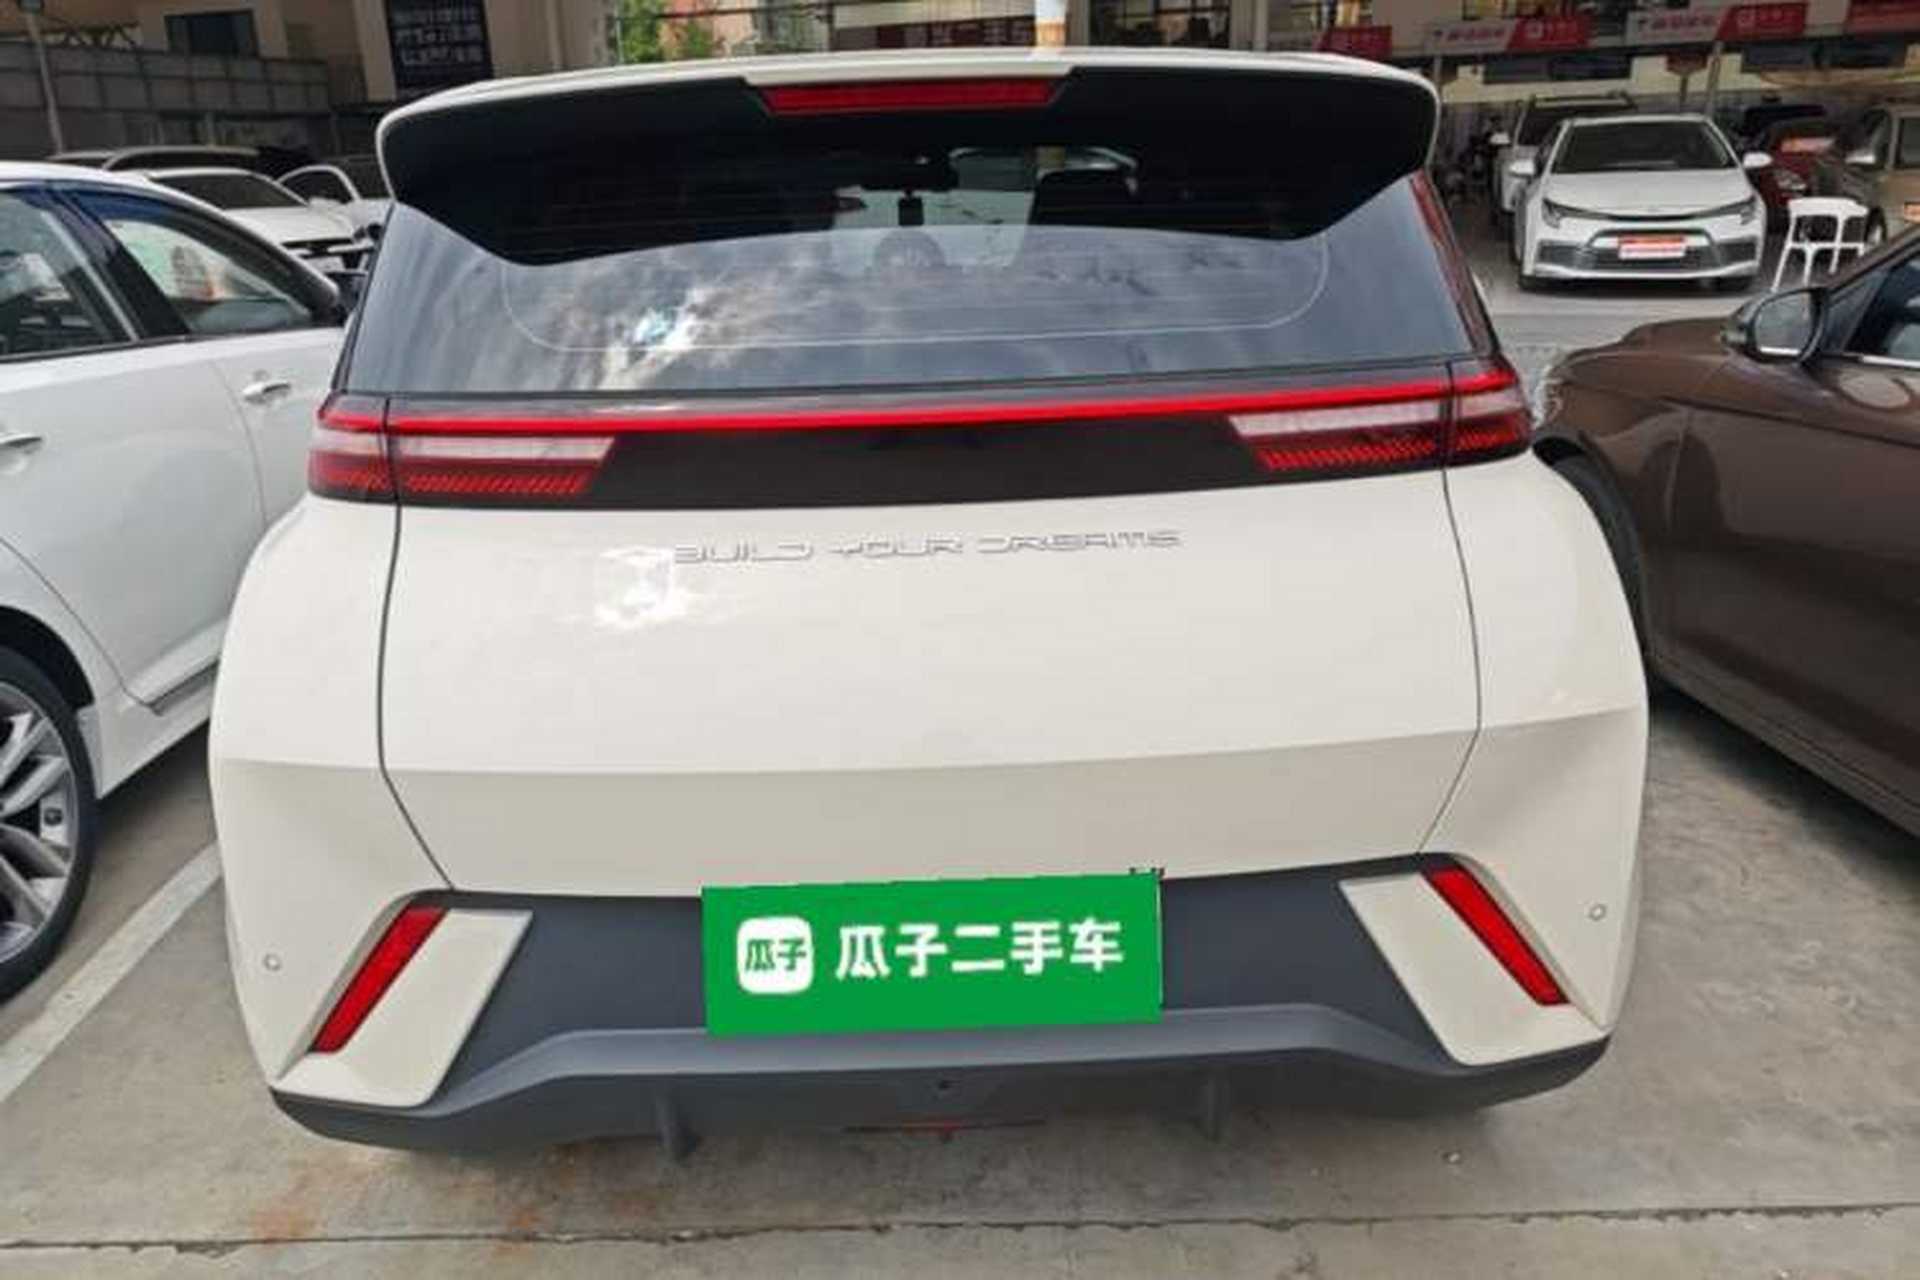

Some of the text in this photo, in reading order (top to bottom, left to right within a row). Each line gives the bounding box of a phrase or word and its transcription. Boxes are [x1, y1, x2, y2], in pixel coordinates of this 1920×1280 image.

[674, 529, 1181, 564] BUILD YOUR DREAMS
